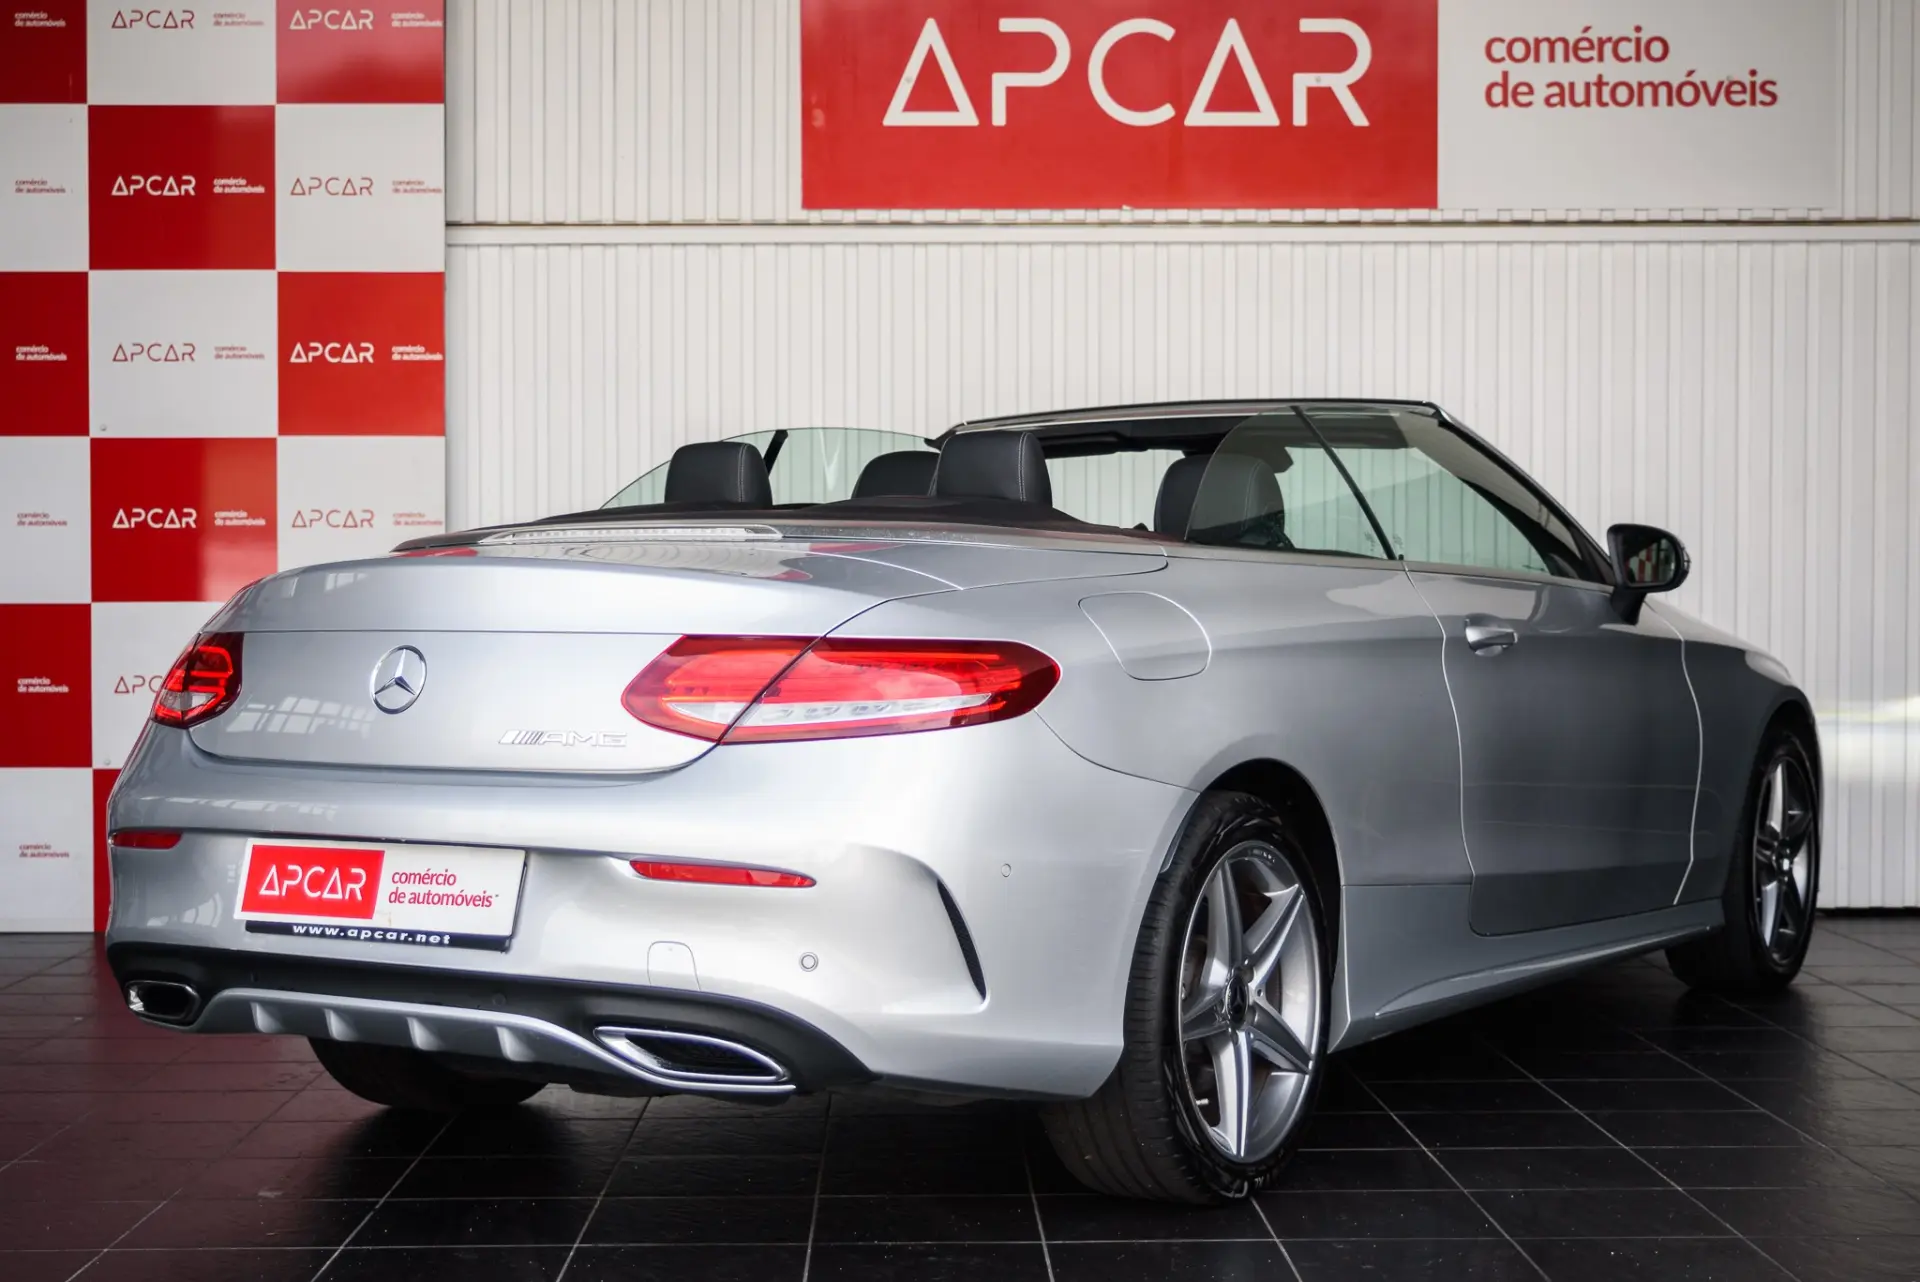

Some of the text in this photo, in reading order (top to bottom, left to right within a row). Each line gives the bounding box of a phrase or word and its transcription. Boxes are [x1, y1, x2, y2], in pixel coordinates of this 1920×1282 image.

[111, 10, 195, 29] APCAR
[289, 10, 374, 30] APCAR
[1485, 25, 1671, 63] comércio
[883, 17, 1372, 127] APCAR
[1485, 70, 1778, 108] de automóveis
[111, 175, 196, 196] APCAR
[290, 177, 374, 196] APCAR
[112, 343, 195, 362] APCAR
[290, 342, 374, 363] APCAR
[112, 508, 197, 529] APCAR
[291, 509, 374, 529] APCAR
[17, 685, 26, 693] de
[114, 675, 163, 694] APC
[540, 731, 627, 747] AMG
[259, 864, 367, 901] APCAR
[392, 868, 457, 886] comércio
[388, 886, 493, 908] de automóveis
[292, 924, 451, 944] www.apcar.net
